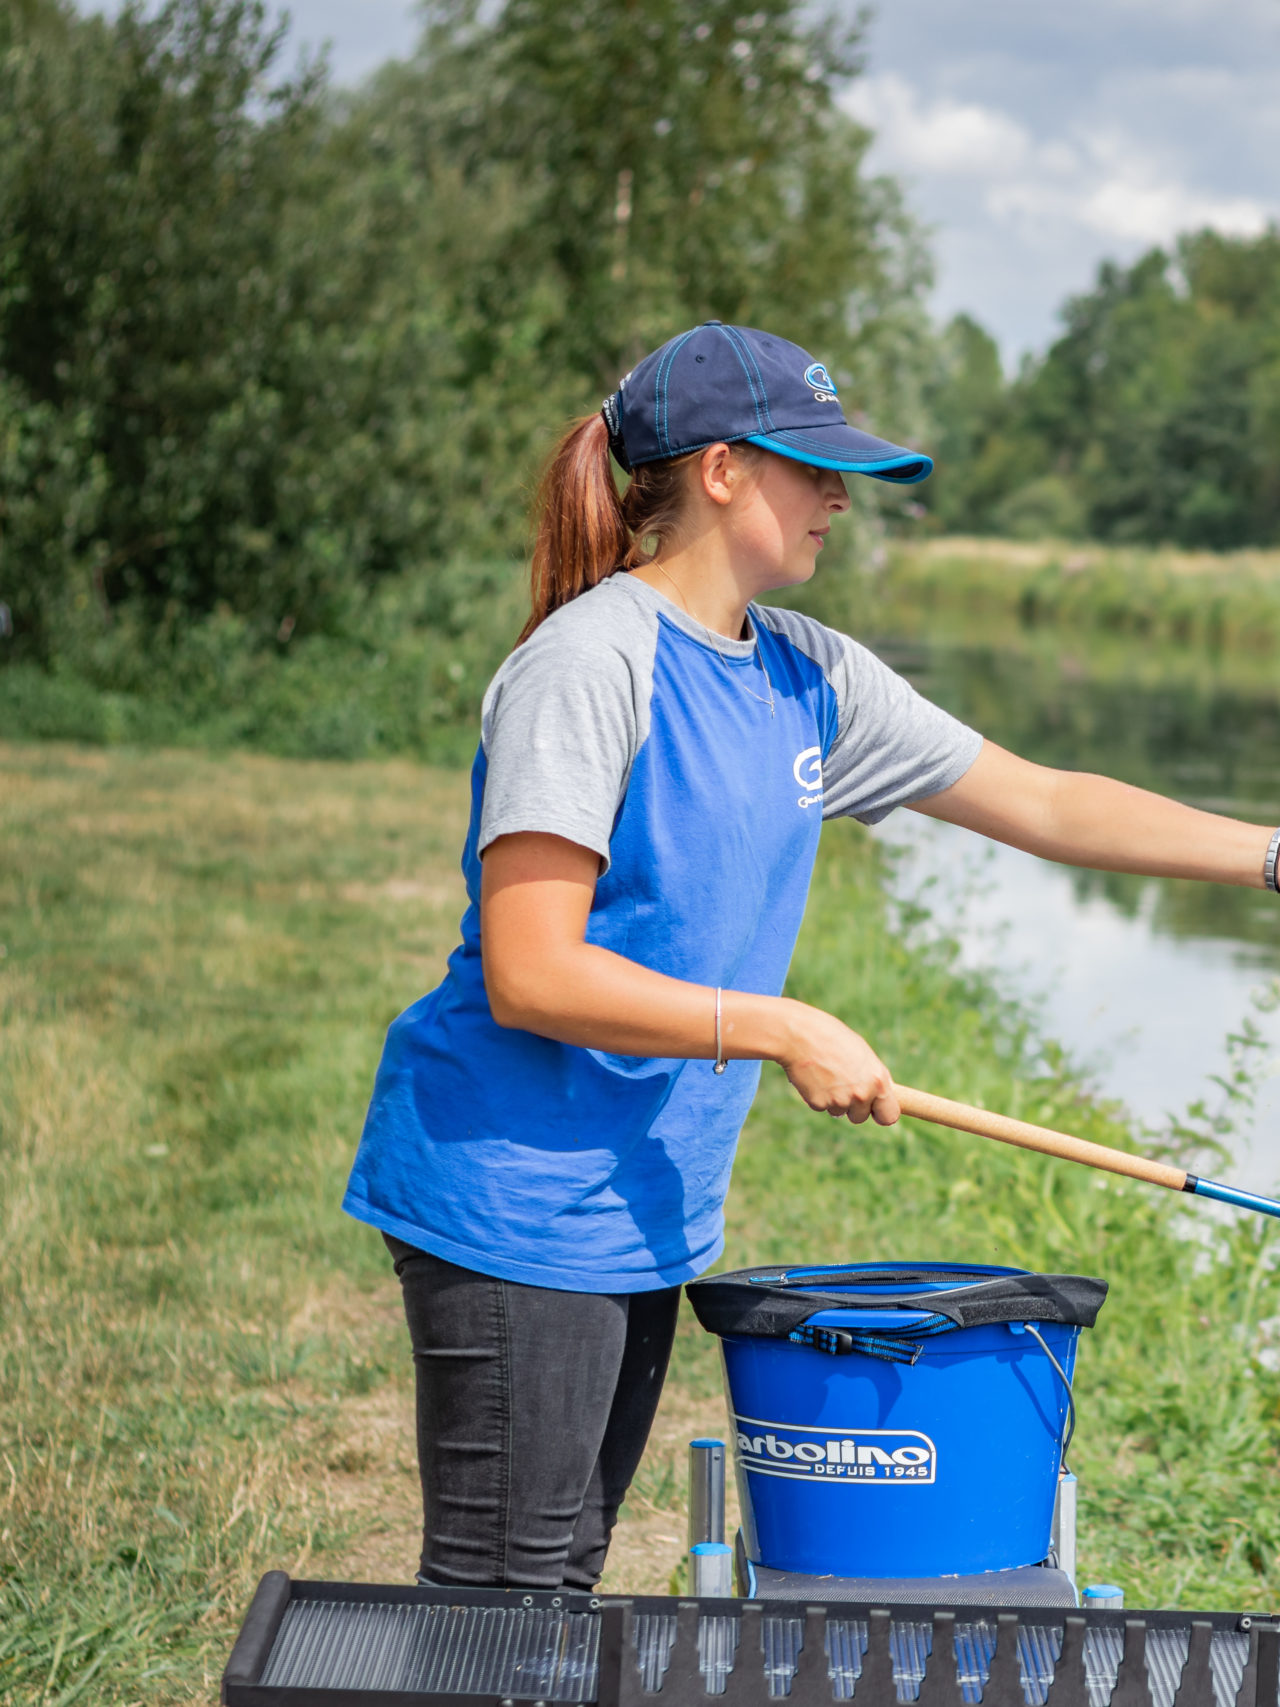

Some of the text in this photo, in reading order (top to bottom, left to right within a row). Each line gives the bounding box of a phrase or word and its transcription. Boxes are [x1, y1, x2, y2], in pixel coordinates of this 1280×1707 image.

[738, 1432, 930, 1465] arbolino
[814, 1464, 929, 1477] DEPUIS 1945
